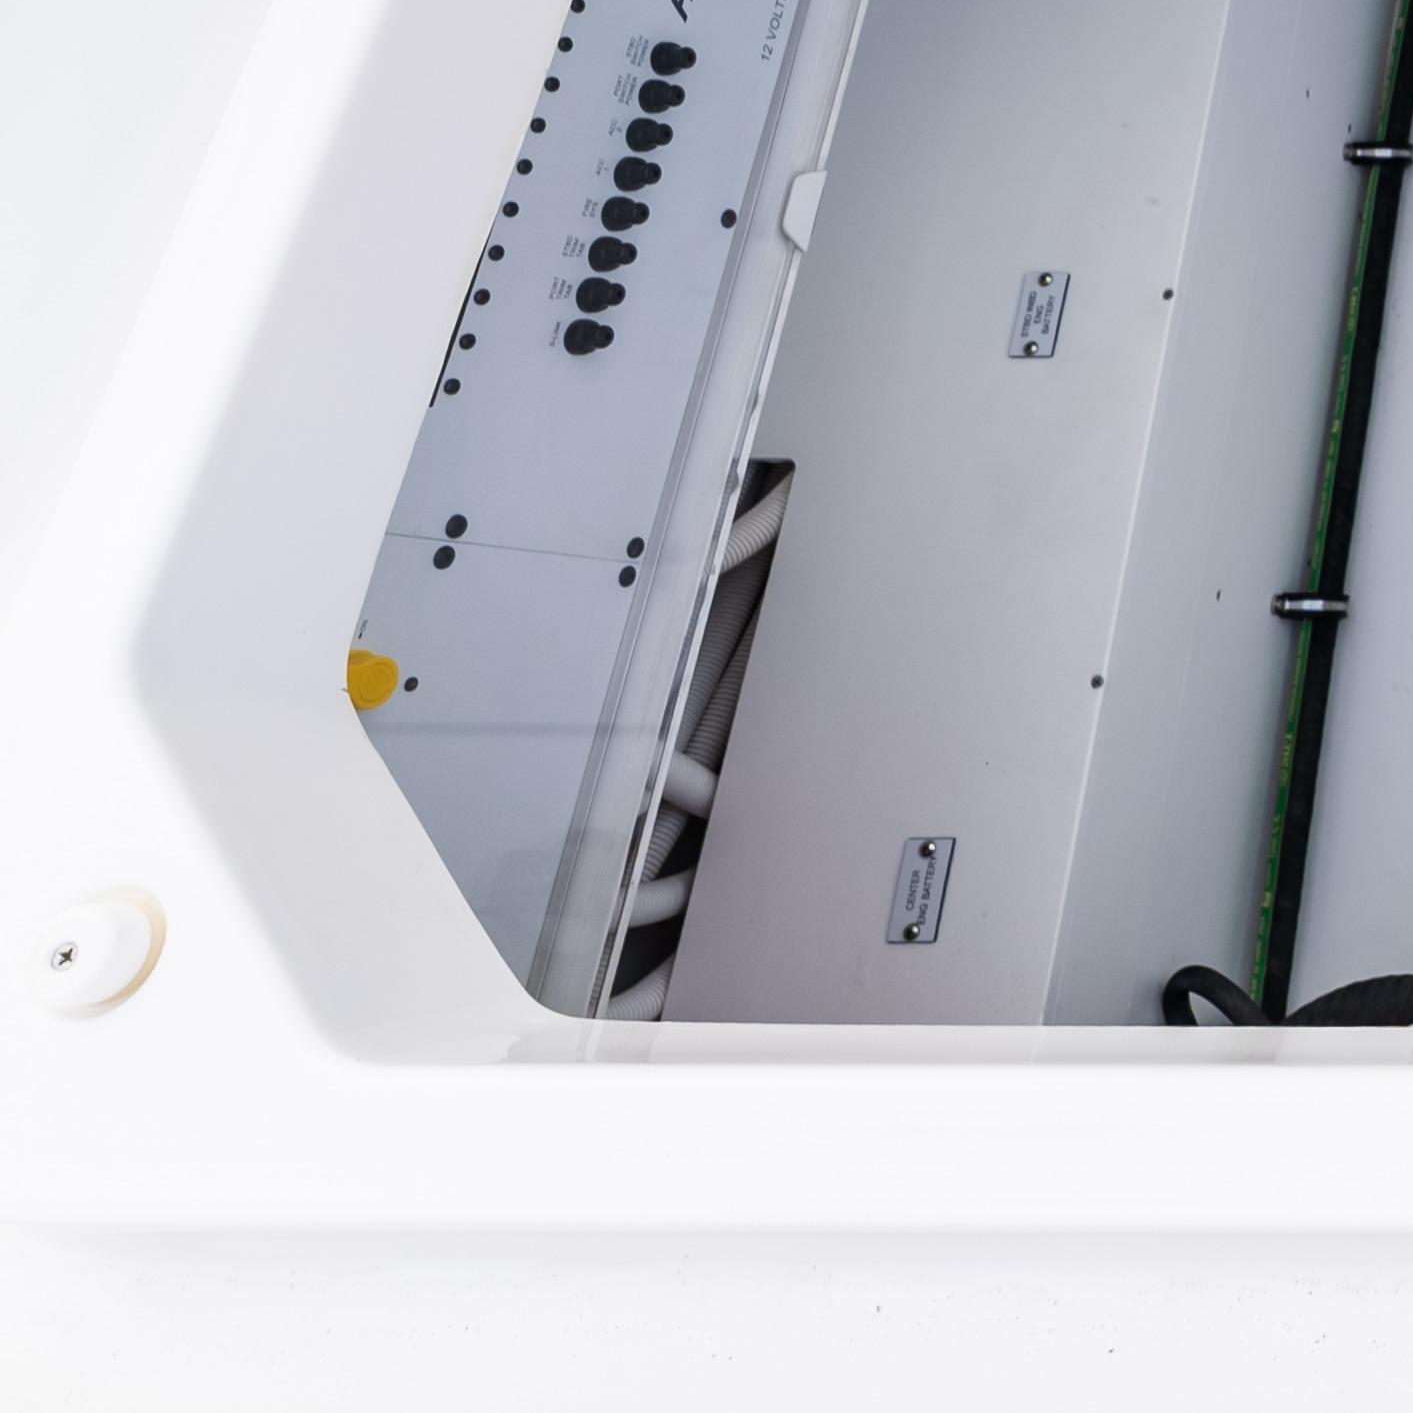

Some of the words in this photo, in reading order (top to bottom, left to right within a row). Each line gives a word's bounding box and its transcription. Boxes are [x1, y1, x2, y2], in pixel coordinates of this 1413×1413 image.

[761, 44, 772, 60] 12
[1041, 295, 1054, 334] BATTERY
[906, 870, 919, 910] CENTER
[921, 856, 936, 898] BATTERY
[917, 904, 927, 924] ENG
